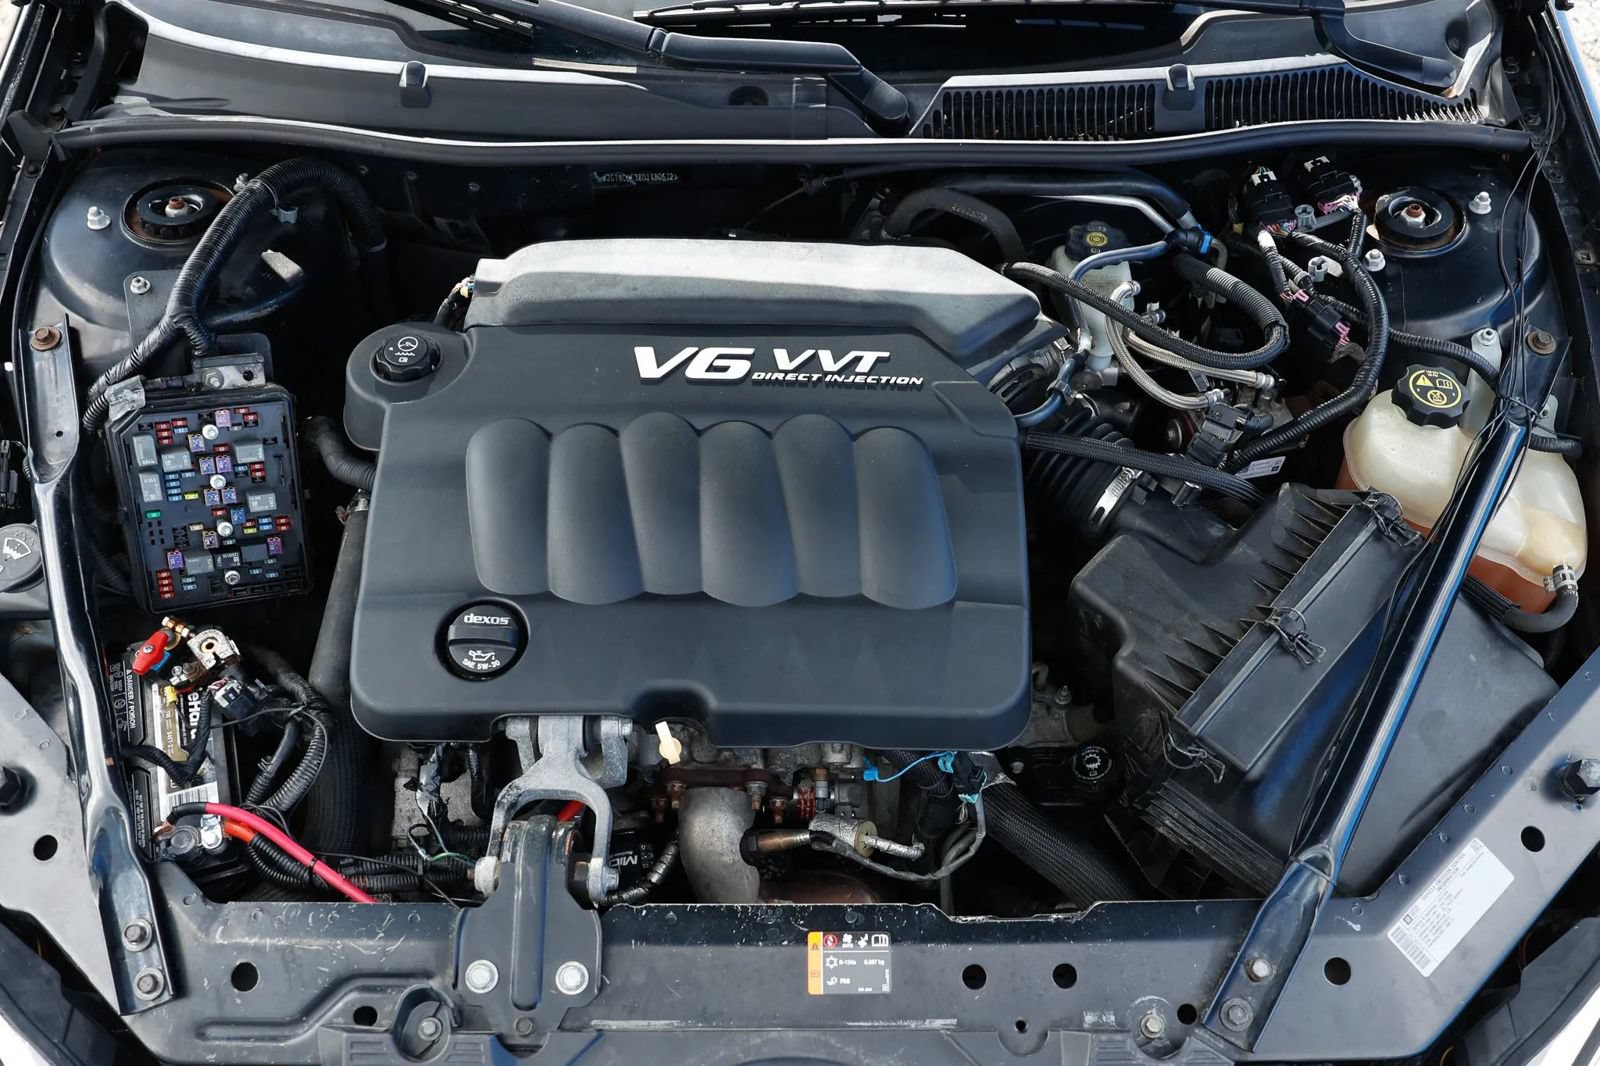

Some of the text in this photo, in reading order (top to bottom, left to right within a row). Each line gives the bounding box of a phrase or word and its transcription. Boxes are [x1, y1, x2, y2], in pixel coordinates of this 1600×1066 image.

[633, 346, 890, 379] V6 VVT
[751, 372, 923, 385] DIRECT INJECTION
[463, 612, 511, 625] dexos
[462, 658, 500, 670] SAE 5W-30
[126, 675, 135, 700] DANGER
[128, 705, 137, 729] POISON
